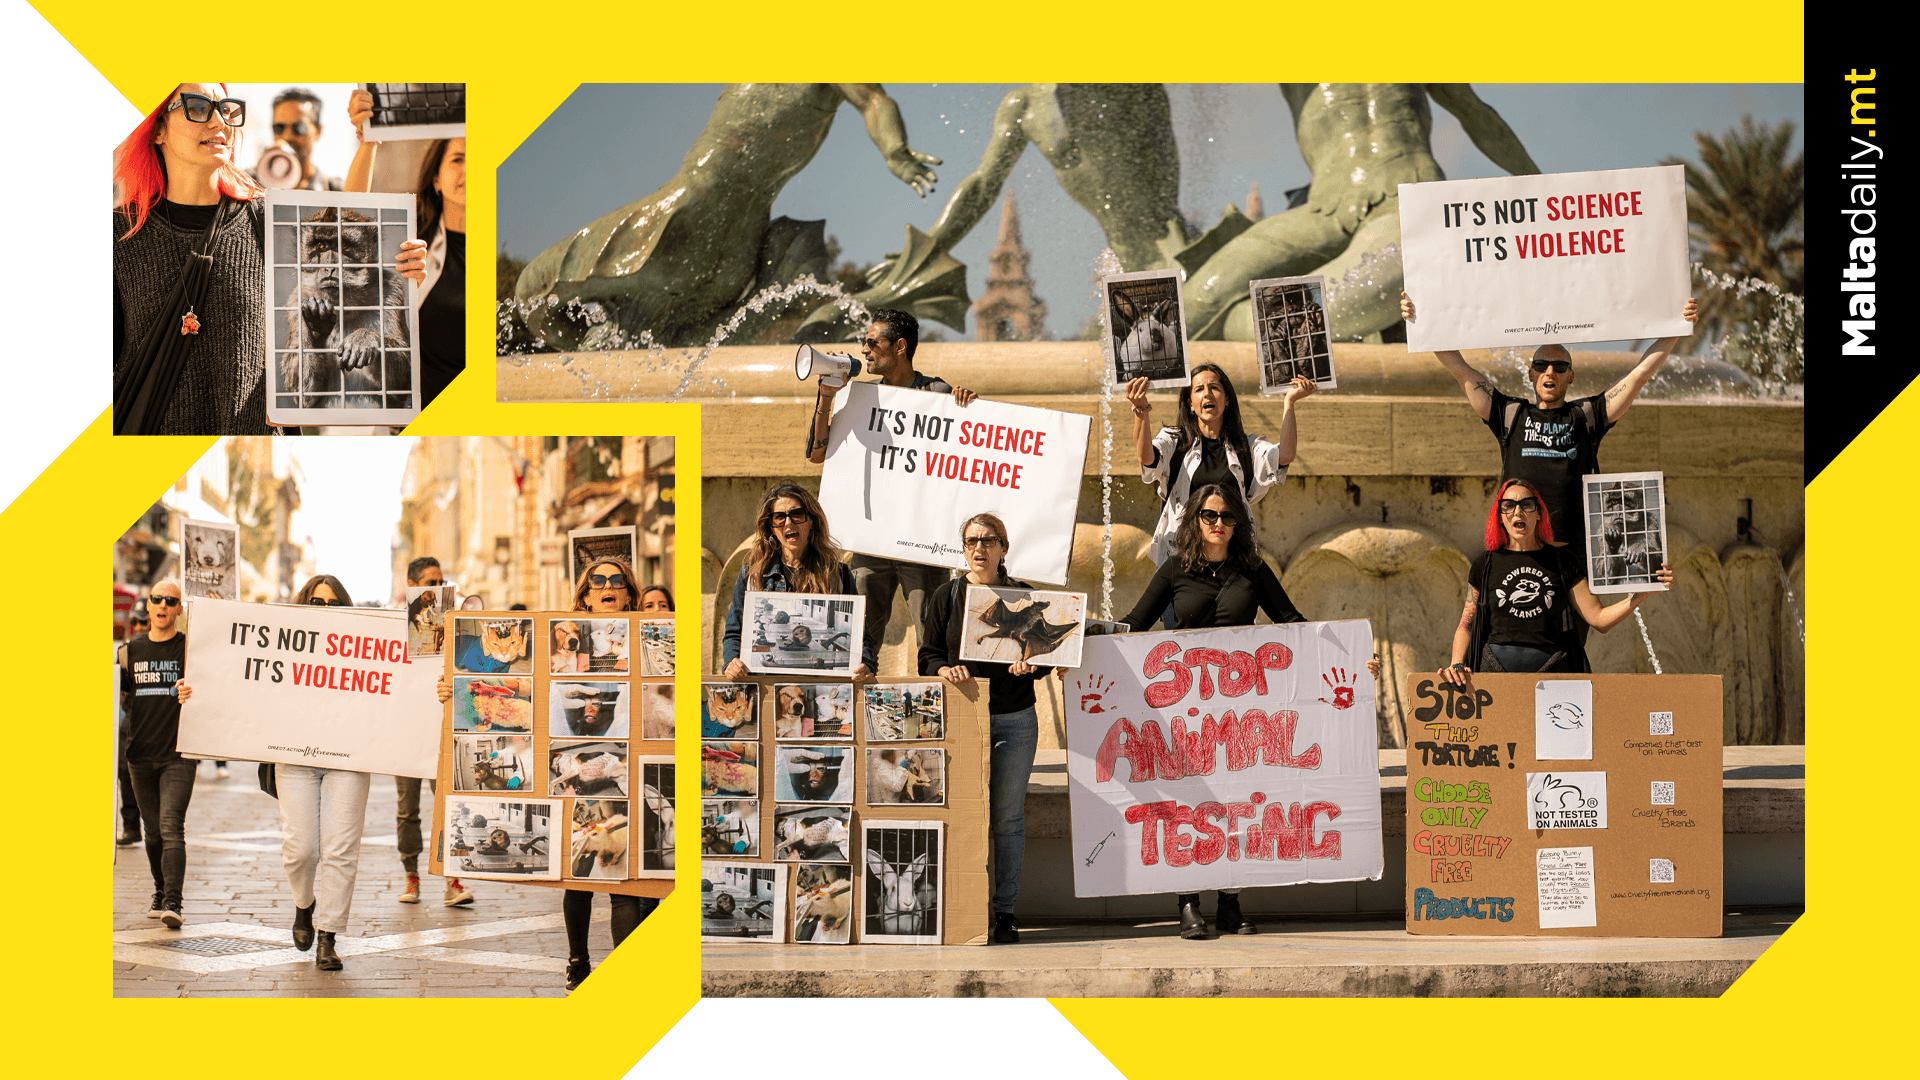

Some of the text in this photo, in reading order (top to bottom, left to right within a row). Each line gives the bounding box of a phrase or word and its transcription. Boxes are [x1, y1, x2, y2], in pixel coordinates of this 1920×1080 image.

[1444, 191, 1642, 228] IT'S NOT SCIENCE
[1465, 229, 1626, 262] IT'S VIOLENCE
[868, 407, 1046, 456] IT'S NOT SCIENCE
[1524, 429, 1554, 447] THEIRS
[879, 444, 1024, 490] IT'S VIOLENCE
[1502, 566, 1552, 586] POWERED BY
[1509, 606, 1542, 618] PLANTS
[230, 622, 270, 648] IT'S
[278, 628, 320, 654] NOT
[134, 660, 180, 672] OUR PLANET.
[134, 672, 160, 684] THEIRS
[244, 657, 393, 695] IT'S VIOLENCE
[1143, 640, 1293, 708] STOP
[1415, 680, 1494, 722] STOP
[1424, 722, 1478, 742] THIS
[316, 750, 350, 758] EVERYWHERE
[1624, 740, 1662, 752] Companies
[1414, 777, 1492, 804] CHOOSE
[1420, 806, 1488, 829] ONLY
[1536, 810, 1598, 819] NOT TESTED
[1536, 819, 1598, 828] ON ANIMALS
[1632, 808, 1664, 820] Cruelty
[1413, 830, 1512, 859] CRUELTY
[1431, 858, 1472, 883] FREE
[1414, 887, 1515, 922] PRODUCTS
